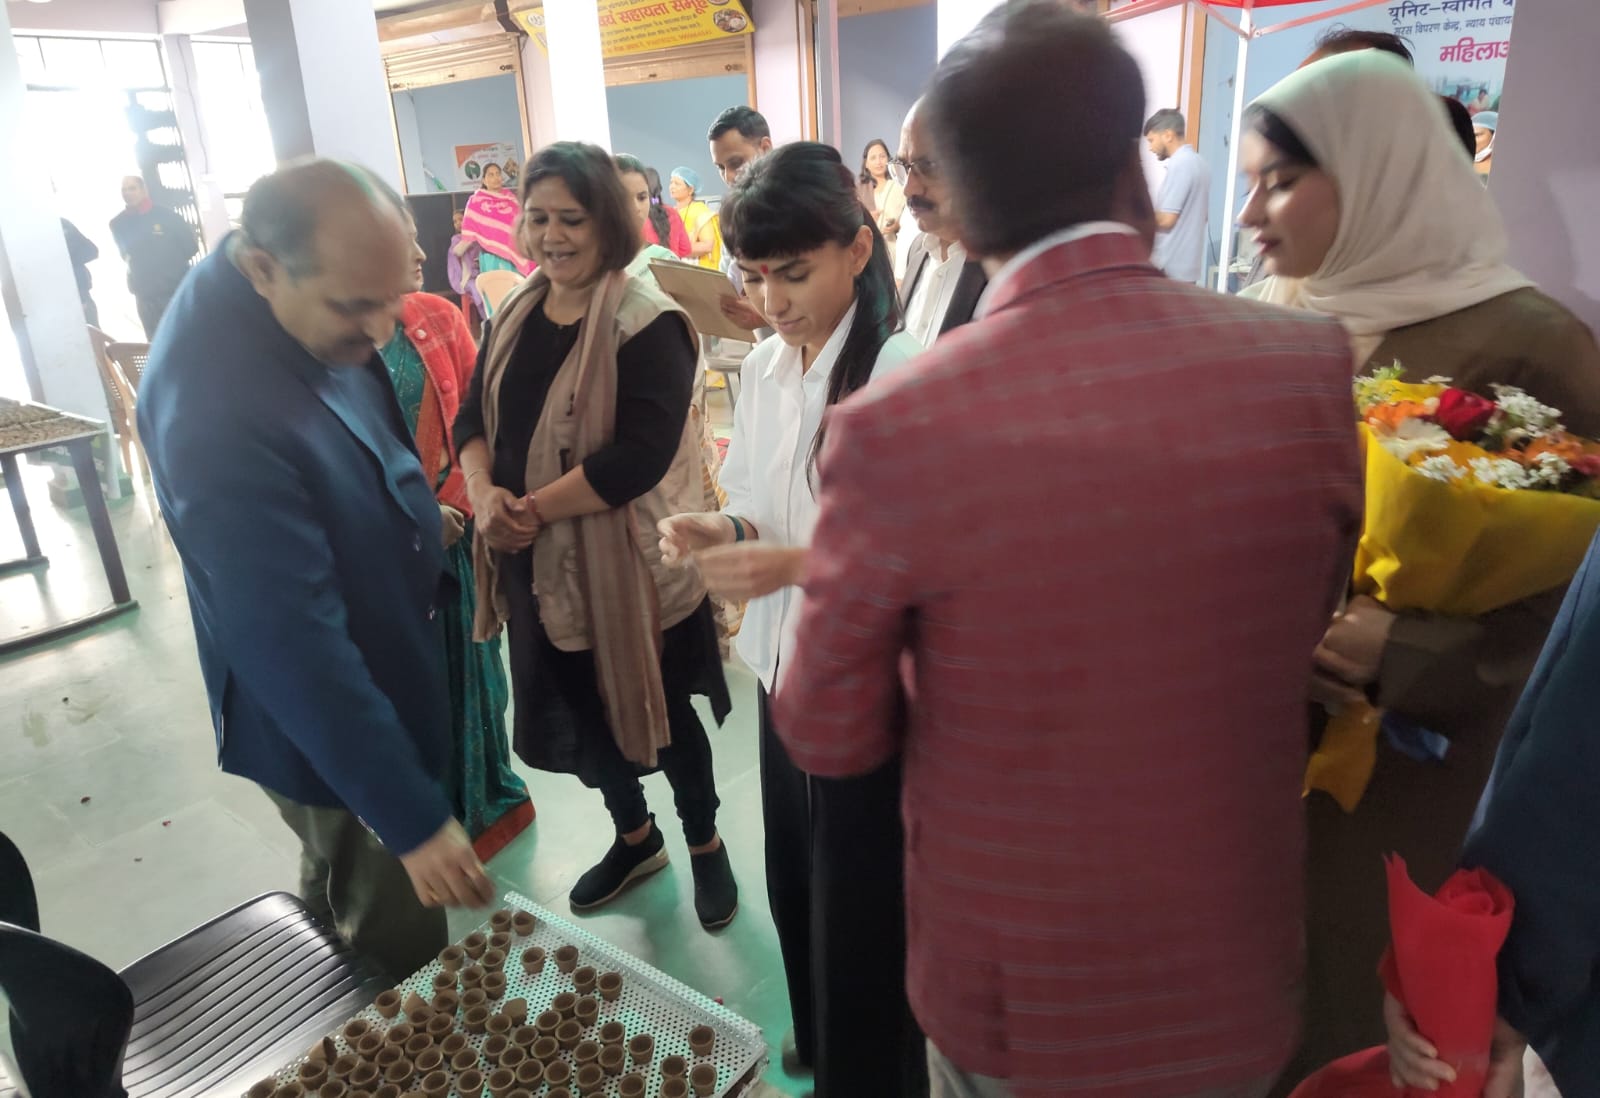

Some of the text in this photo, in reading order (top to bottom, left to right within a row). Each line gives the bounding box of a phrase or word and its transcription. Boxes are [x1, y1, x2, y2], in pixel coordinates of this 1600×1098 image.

[599, 10, 617, 26] वयं
[617, 3, 669, 23] सहायता
[670, 0, 708, 14] समूह
